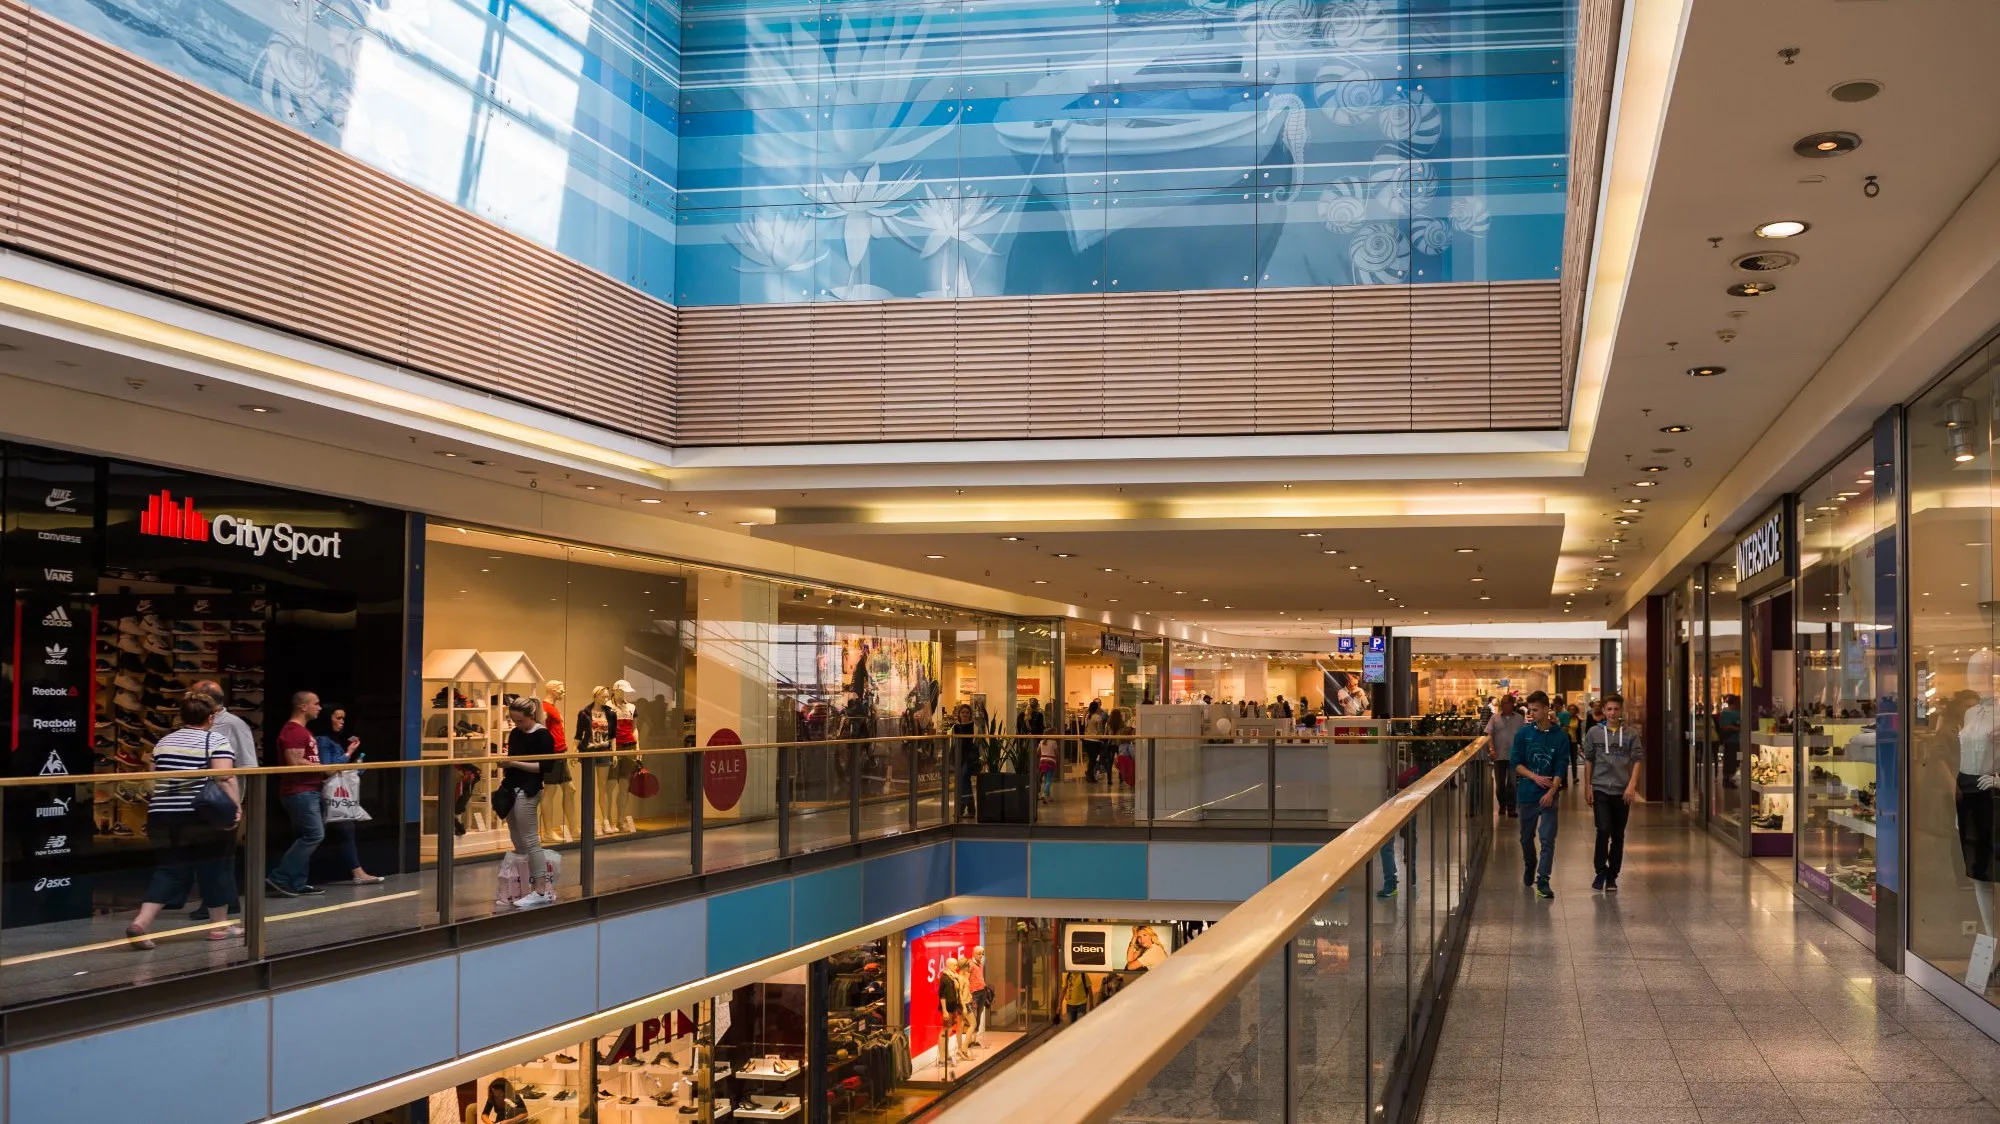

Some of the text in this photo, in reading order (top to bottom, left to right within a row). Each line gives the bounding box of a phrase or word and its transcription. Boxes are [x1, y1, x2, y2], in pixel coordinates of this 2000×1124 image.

[50, 488, 72, 499] NIKE
[38, 532, 81, 543] CONVERSE
[212, 514, 341, 560] City Sport
[1736, 513, 1780, 583] INTERSHOE
[44, 568, 73, 582] VANS
[1373, 638, 1382, 647] P
[32, 687, 67, 696] Reebok
[33, 719, 77, 729] Reebok
[710, 759, 740, 775] SALE
[36, 807, 65, 818] PUMA
[1072, 944, 1104, 953] olsen
